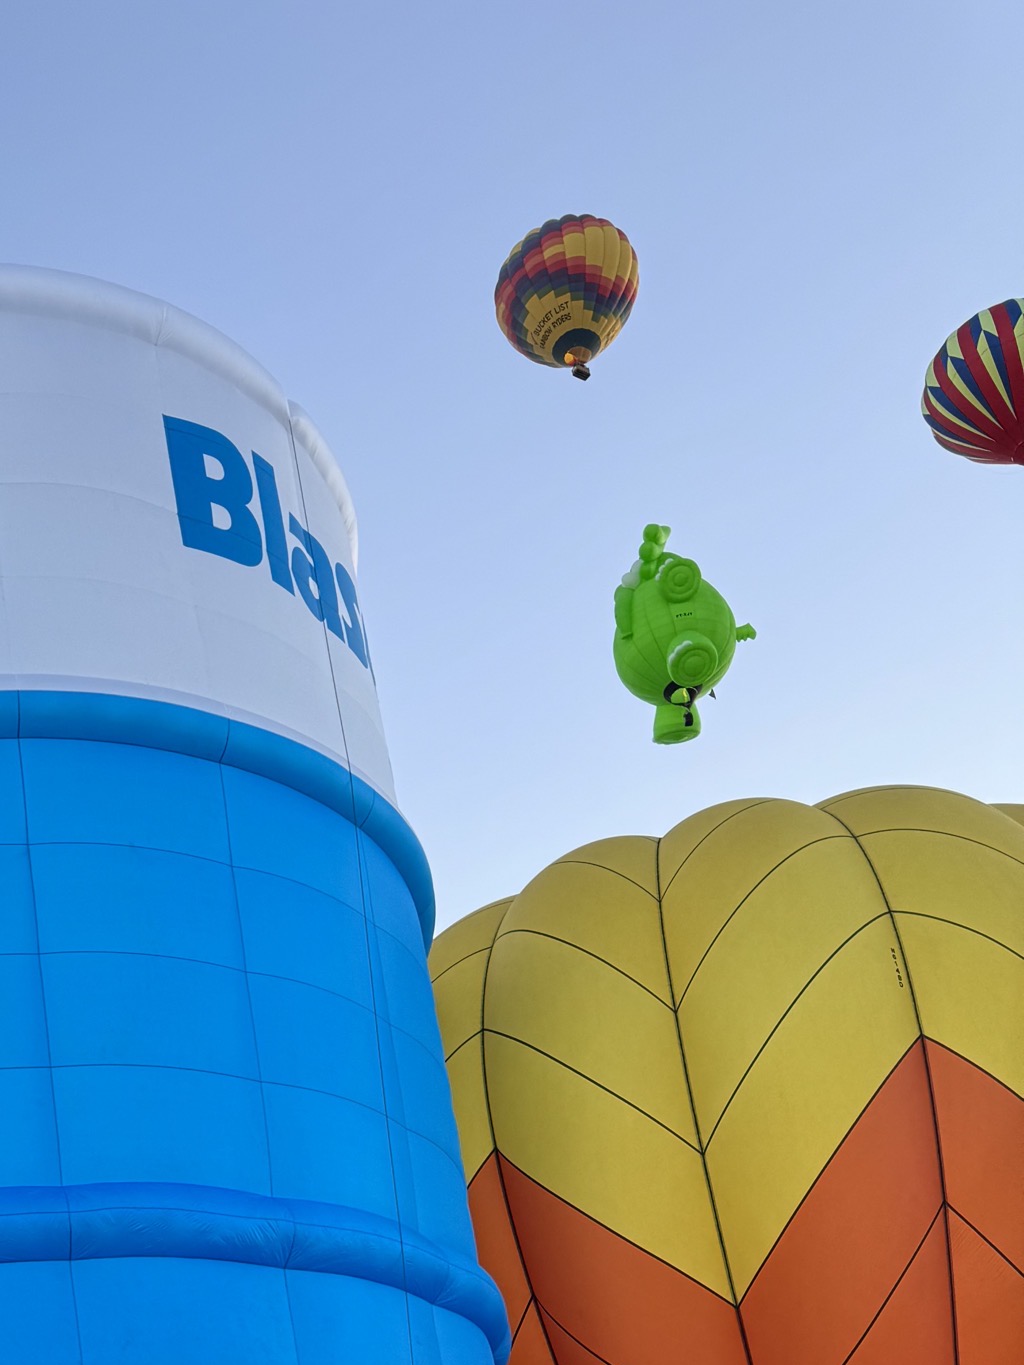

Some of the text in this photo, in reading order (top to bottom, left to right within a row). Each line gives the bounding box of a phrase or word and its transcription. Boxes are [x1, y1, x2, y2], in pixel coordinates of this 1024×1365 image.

[533, 300, 569, 337] BUCKET LIST
[162, 413, 376, 687] Blas
